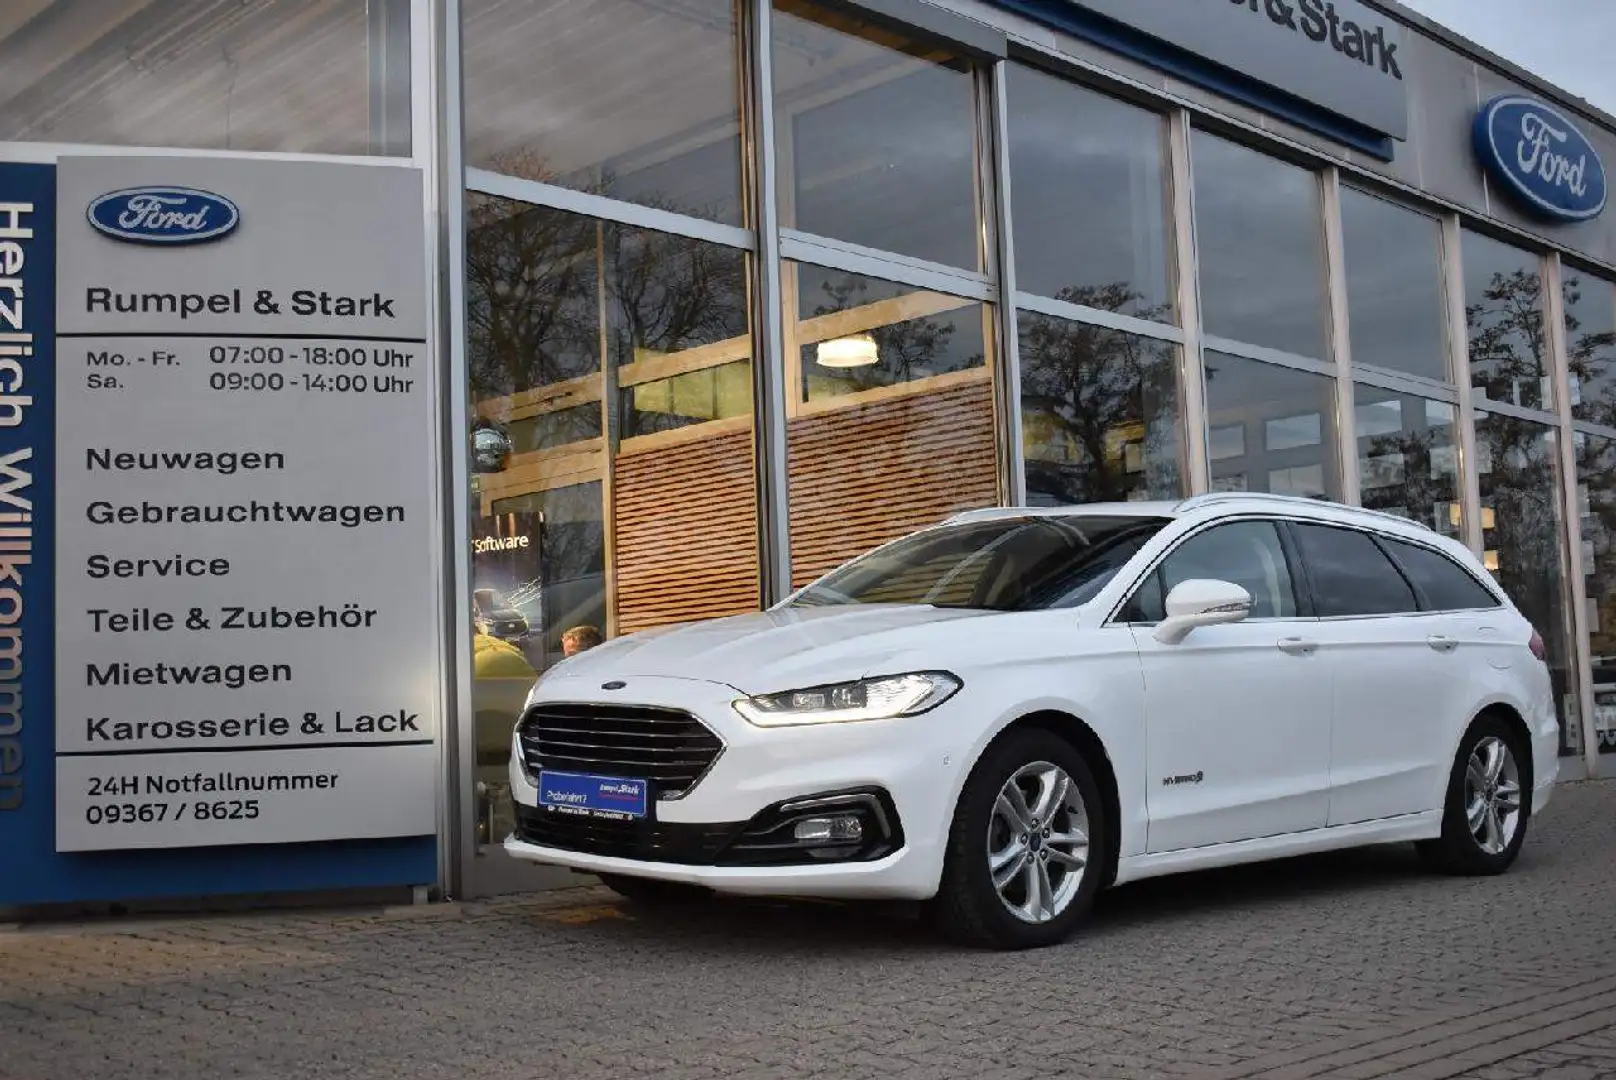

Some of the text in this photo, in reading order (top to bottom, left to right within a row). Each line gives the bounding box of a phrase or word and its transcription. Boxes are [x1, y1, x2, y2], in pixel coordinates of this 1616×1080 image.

[1516, 112, 1587, 197] Ford
[118, 194, 209, 229] Ford
[0, 202, 34, 427] Herzlich
[86, 287, 396, 319] Rumpel & Stark
[86, 351, 131, 367] Mo.
[152, 350, 181, 366] Fr.
[373, 348, 414, 368] Uhr
[86, 373, 124, 390] Sa.
[373, 375, 414, 393] Uhr
[86, 448, 284, 475] Neuwagen
[86, 501, 405, 527] Gebrauchtwagen
[475, 535, 529, 553] Software
[86, 554, 230, 579] Service
[0, 447, 33, 811] Willkommen
[86, 603, 378, 633] Teile & Zubehör
[86, 662, 292, 689] Mietwagen
[86, 709, 419, 742] Karosserie & Lack
[87, 771, 339, 796] 24H Notfallnummer
[85, 803, 169, 825] 09367
[193, 799, 260, 821] 8625
